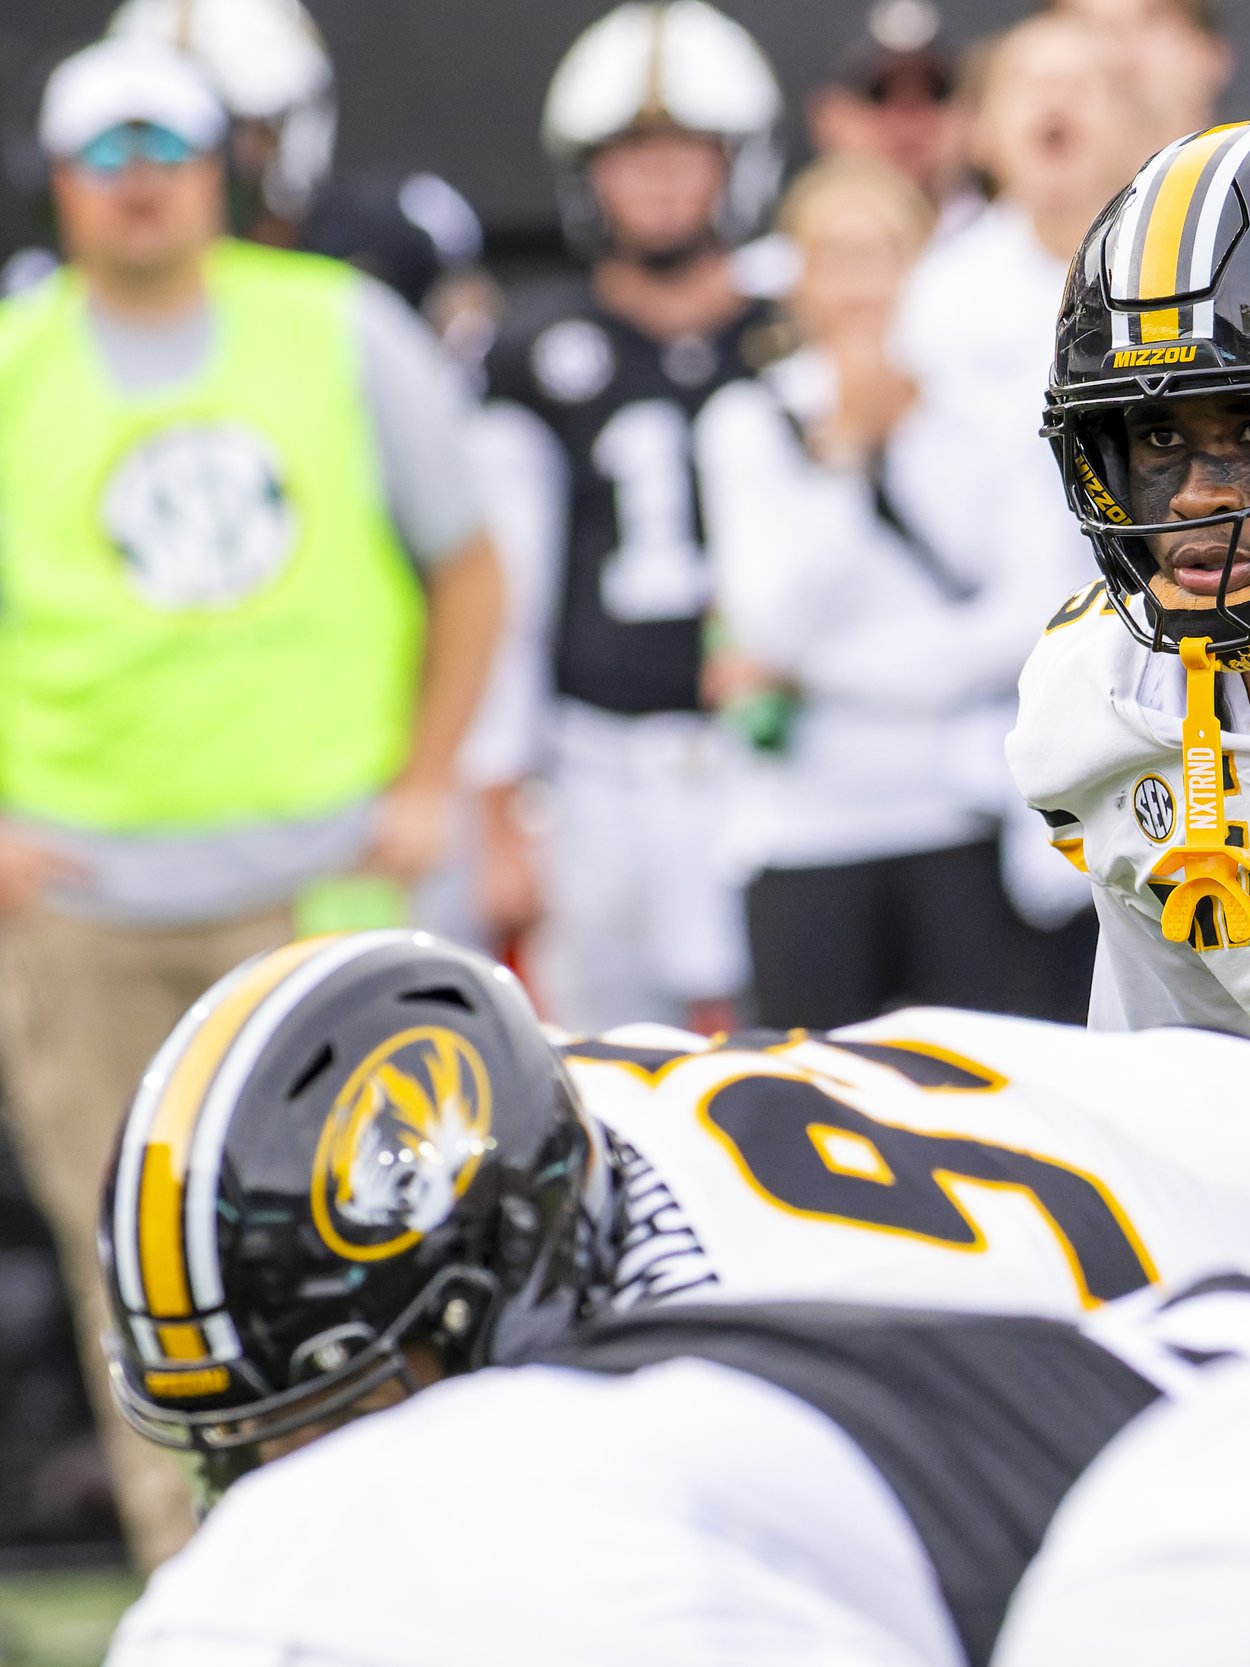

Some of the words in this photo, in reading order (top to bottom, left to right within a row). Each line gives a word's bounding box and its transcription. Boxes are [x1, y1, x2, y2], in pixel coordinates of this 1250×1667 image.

[1113, 346, 1197, 369] MIZZOU
[1075, 453, 1134, 526] MIZZO
[1134, 777, 1174, 839] SEC
[1187, 747, 1217, 829] NXTRND
